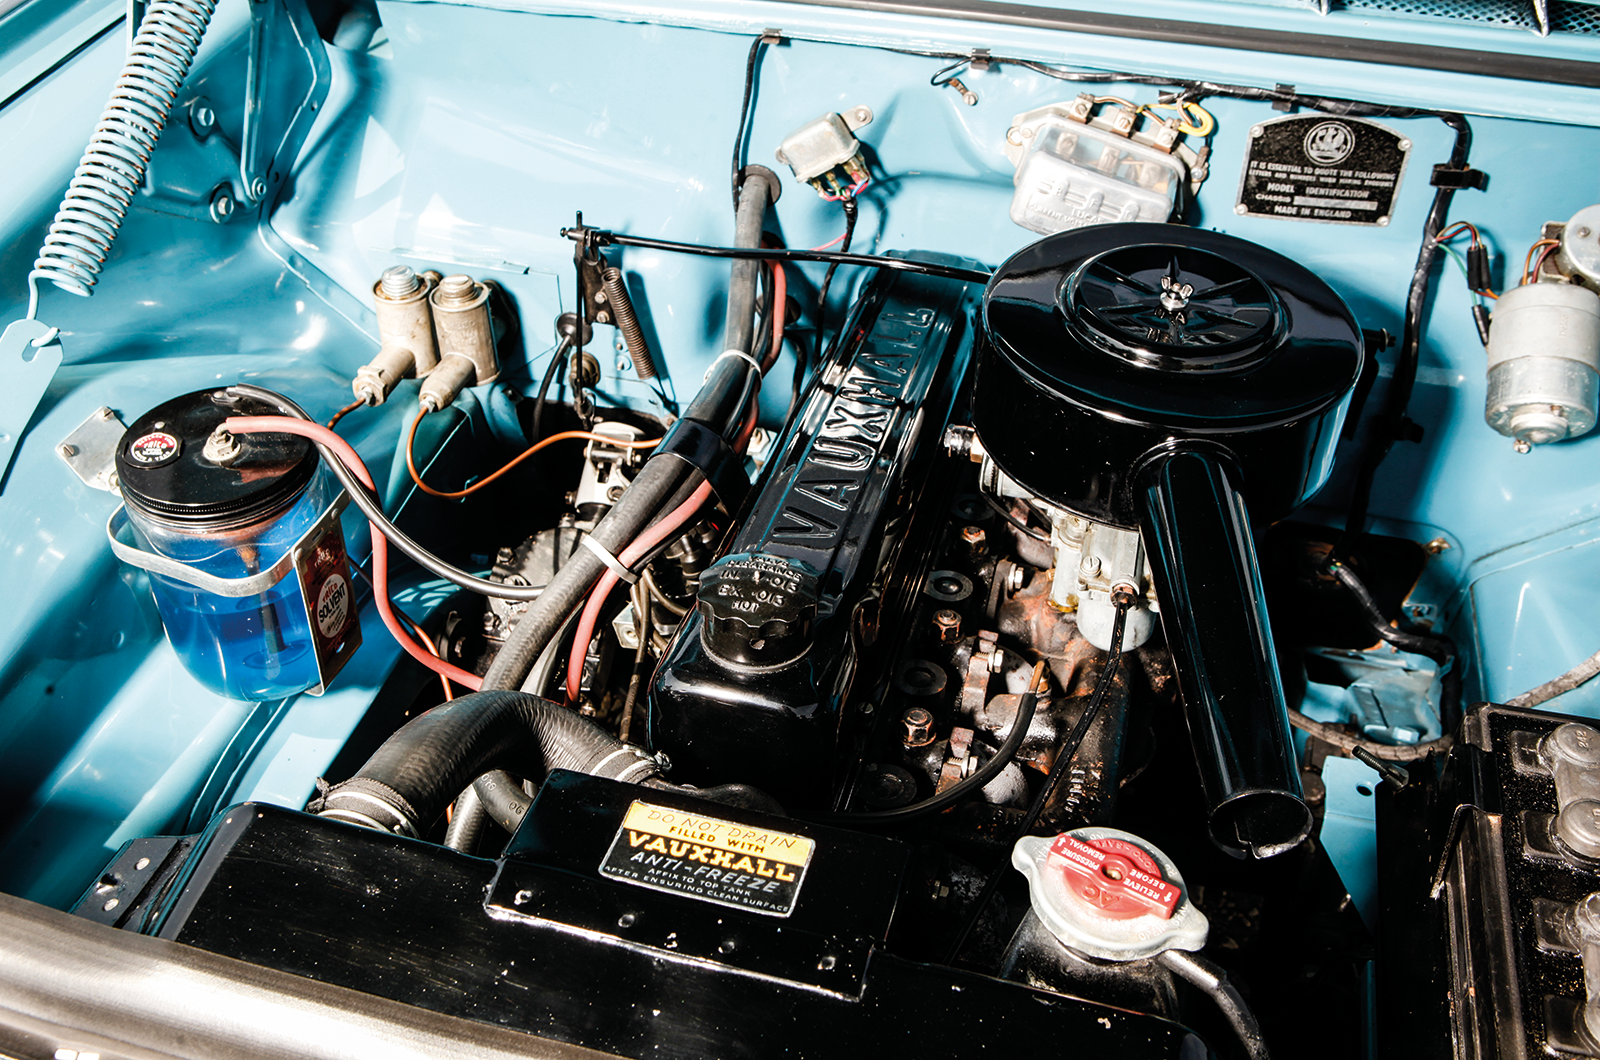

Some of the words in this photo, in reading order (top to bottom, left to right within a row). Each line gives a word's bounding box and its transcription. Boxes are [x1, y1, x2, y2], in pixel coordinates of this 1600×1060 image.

[1267, 162, 1302, 174] ESSENTIAL
[1304, 166, 1313, 174] TO
[1354, 170, 1396, 180] FOLLOWING
[1267, 183, 1295, 193] MODEL
[1306, 186, 1370, 199] IDENTIFICATION
[1071, 208, 1104, 222] LUCA
[1274, 205, 1297, 215] MADE
[1314, 208, 1352, 219] ENGLAND
[772, 308, 935, 539] VAUXHALL
[319, 582, 346, 623] SOLVENT
[647, 810, 675, 824] DO
[681, 817, 725, 832] NOT
[727, 826, 797, 849] DRAIN
[669, 825, 716, 843] FILLED
[727, 838, 765, 854] WITH
[628, 830, 796, 882] VAUXHALL
[1061, 847, 1100, 871] PRESSURE
[1068, 838, 1106, 861] REMOVAL
[604, 865, 639, 879] AFTER
[643, 875, 704, 894] ENSURING
[707, 890, 740, 903] CLEAN
[742, 898, 790, 912] SURFACE
[648, 867, 679, 880] AFFIX
[681, 874, 695, 884] TO
[699, 878, 719, 889] TOP
[722, 884, 752, 897] TANK
[1123, 877, 1161, 900] RELIEVE
[1129, 868, 1166, 891] BEFORE
[1081, 884, 1120, 908] AC
